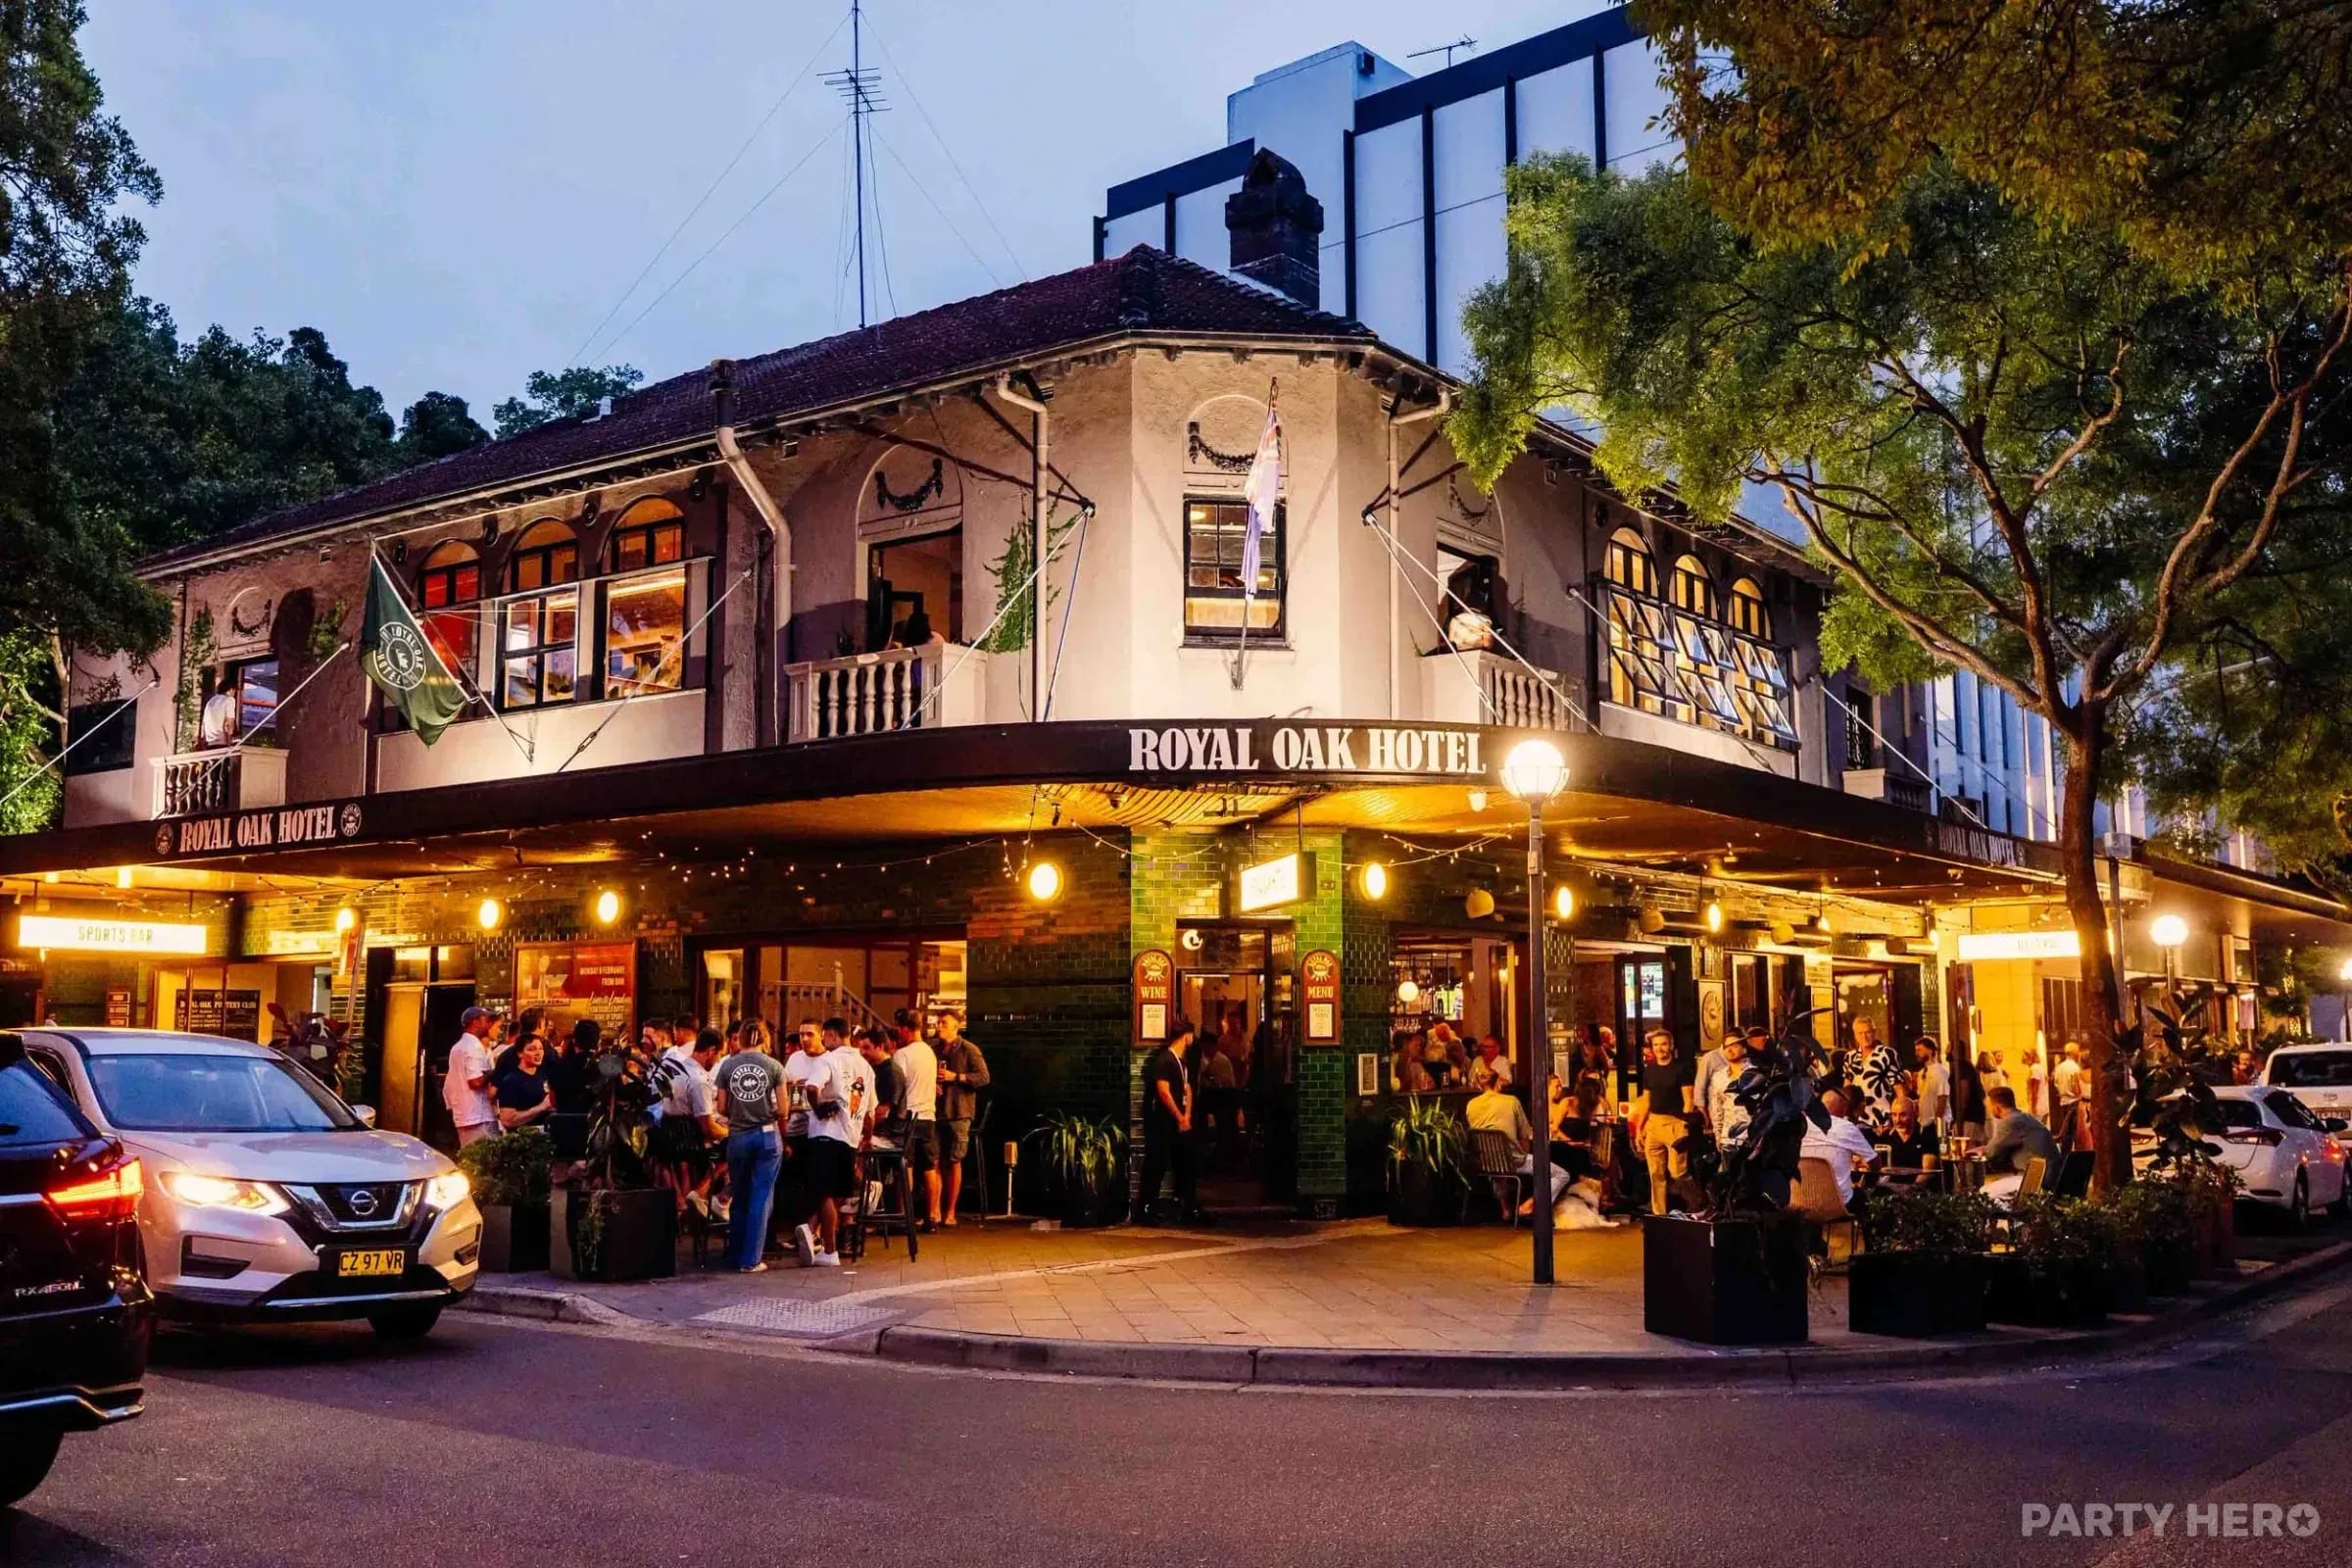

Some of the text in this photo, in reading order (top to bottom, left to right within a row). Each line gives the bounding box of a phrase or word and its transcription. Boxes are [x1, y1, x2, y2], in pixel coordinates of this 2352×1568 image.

[376, 654, 402, 684] HOTEL
[1129, 728, 1487, 774] ROYAL OAK HOTEL
[178, 817, 232, 853] ROYAL
[237, 812, 273, 847] OAK
[277, 806, 337, 844] HOTEL
[1939, 827, 1968, 856] ROYAL
[1970, 831, 1988, 861] OAK
[1988, 836, 2016, 866] HOTEL
[77, 925, 125, 943] SPORTS
[1141, 986, 1168, 999] WINE
[1307, 986, 1334, 999] MENU
[340, 1251, 402, 1271] CZ 97 VR
